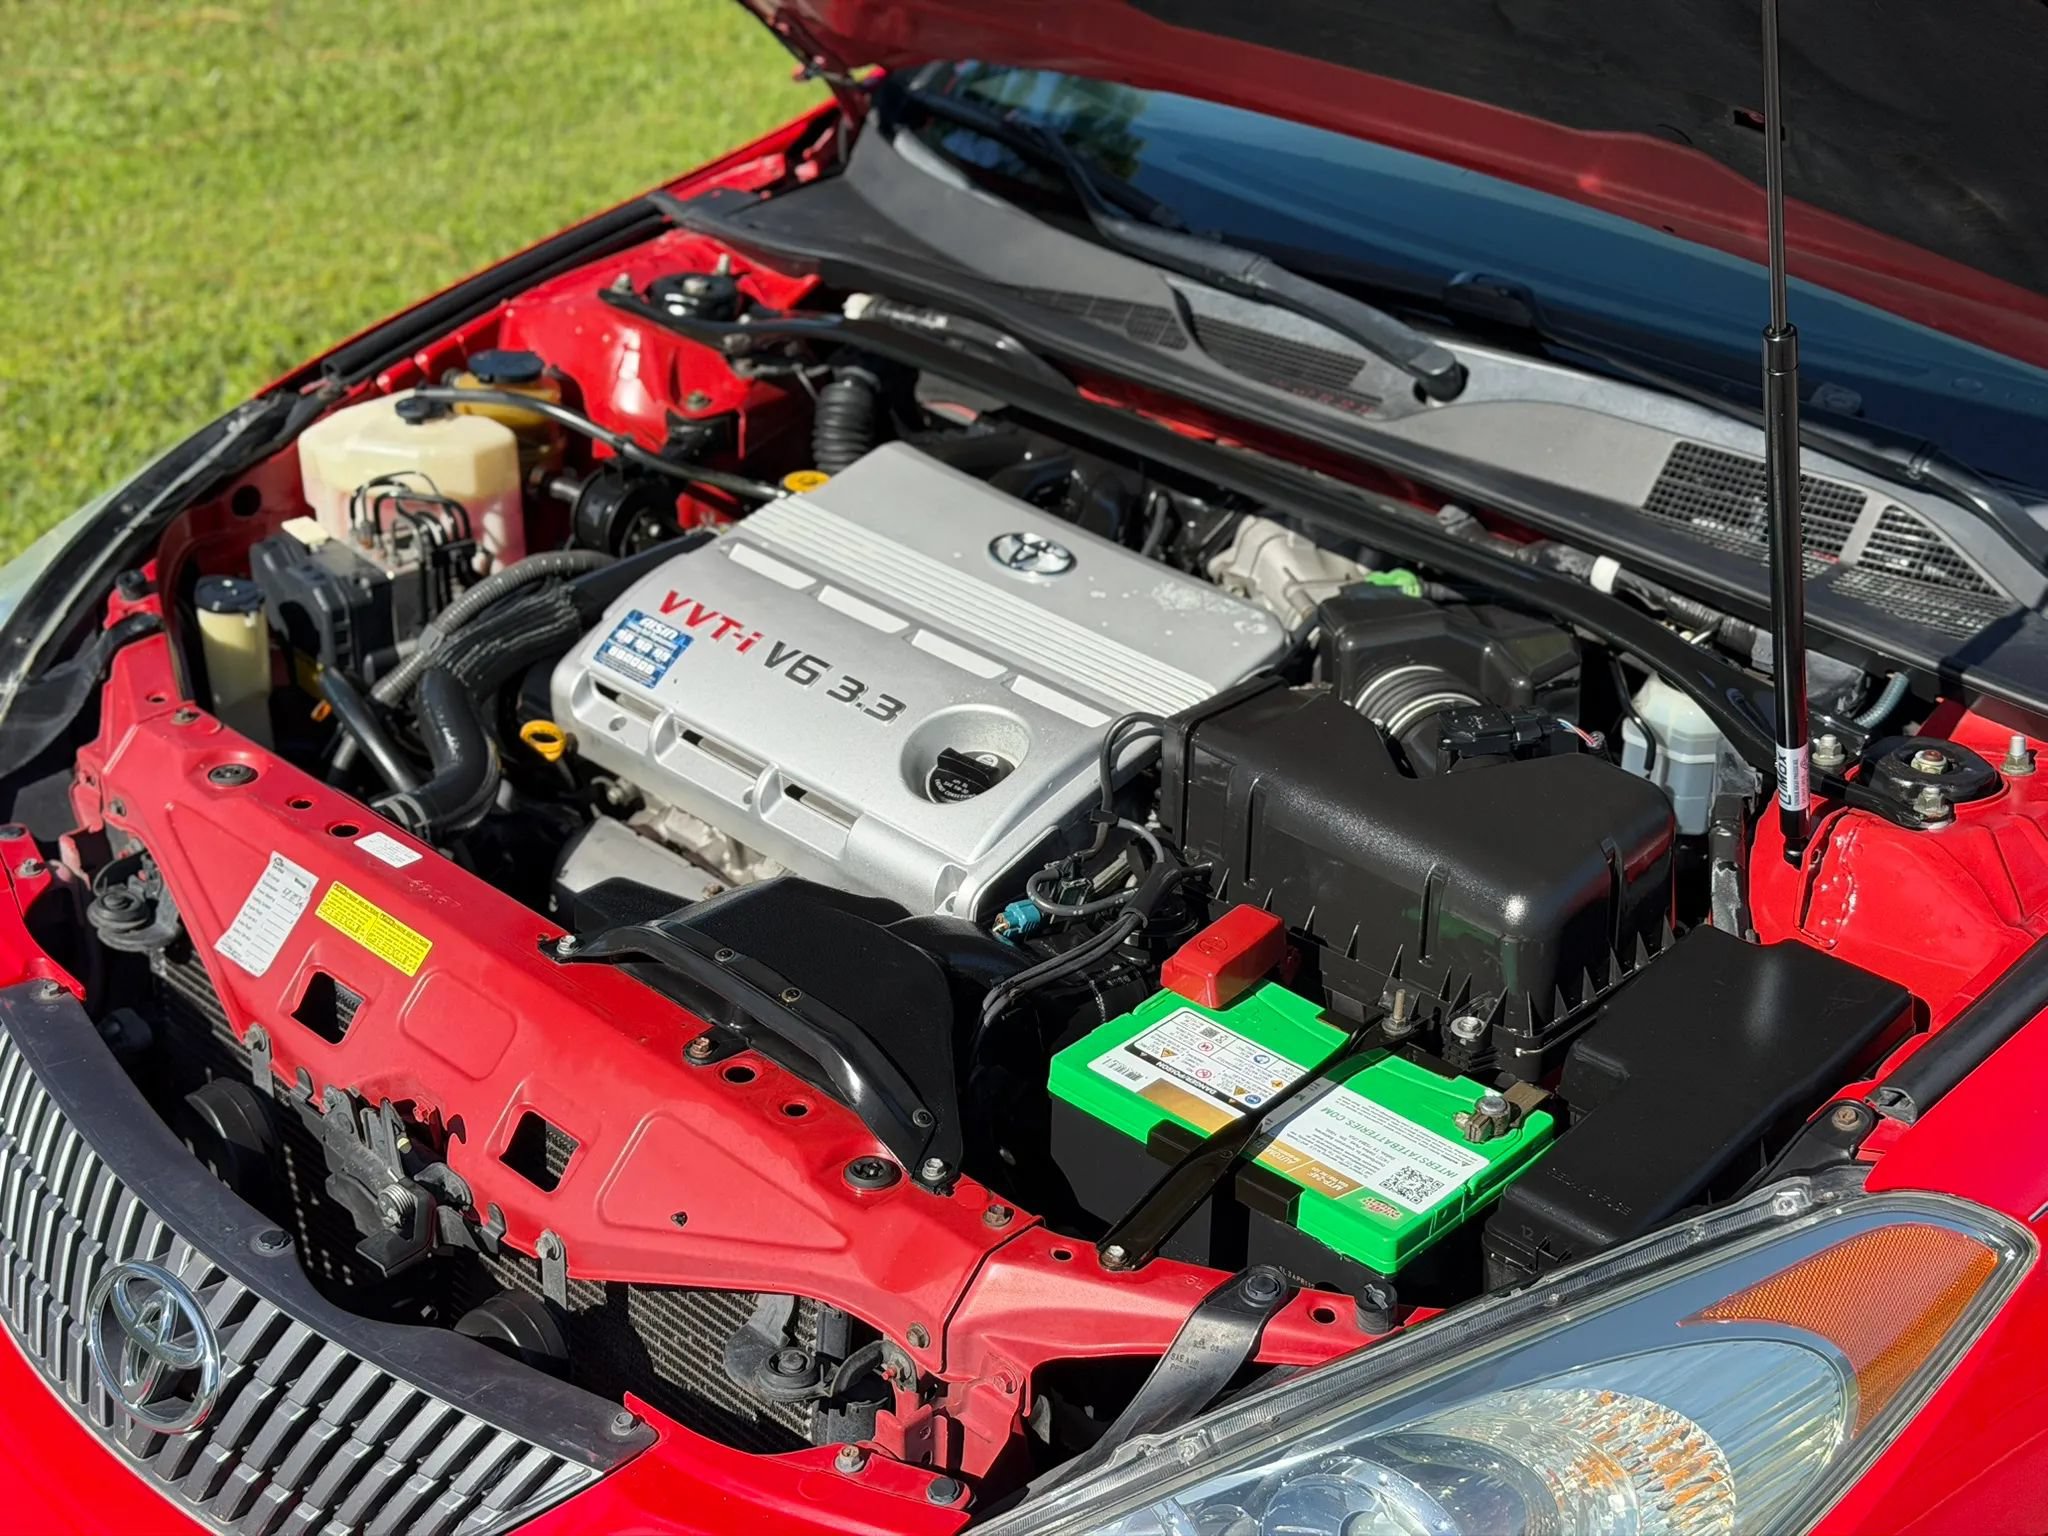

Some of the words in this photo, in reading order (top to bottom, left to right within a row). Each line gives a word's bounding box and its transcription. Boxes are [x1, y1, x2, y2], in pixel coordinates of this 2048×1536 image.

[660, 590, 765, 654] VVT-i
[764, 640, 832, 686] V6
[826, 675, 907, 723] 3.3
[1156, 1061, 1217, 1095] DANGER/POISON
[1318, 1106, 1459, 1178] INTERSTATEBATTERIES.COM
